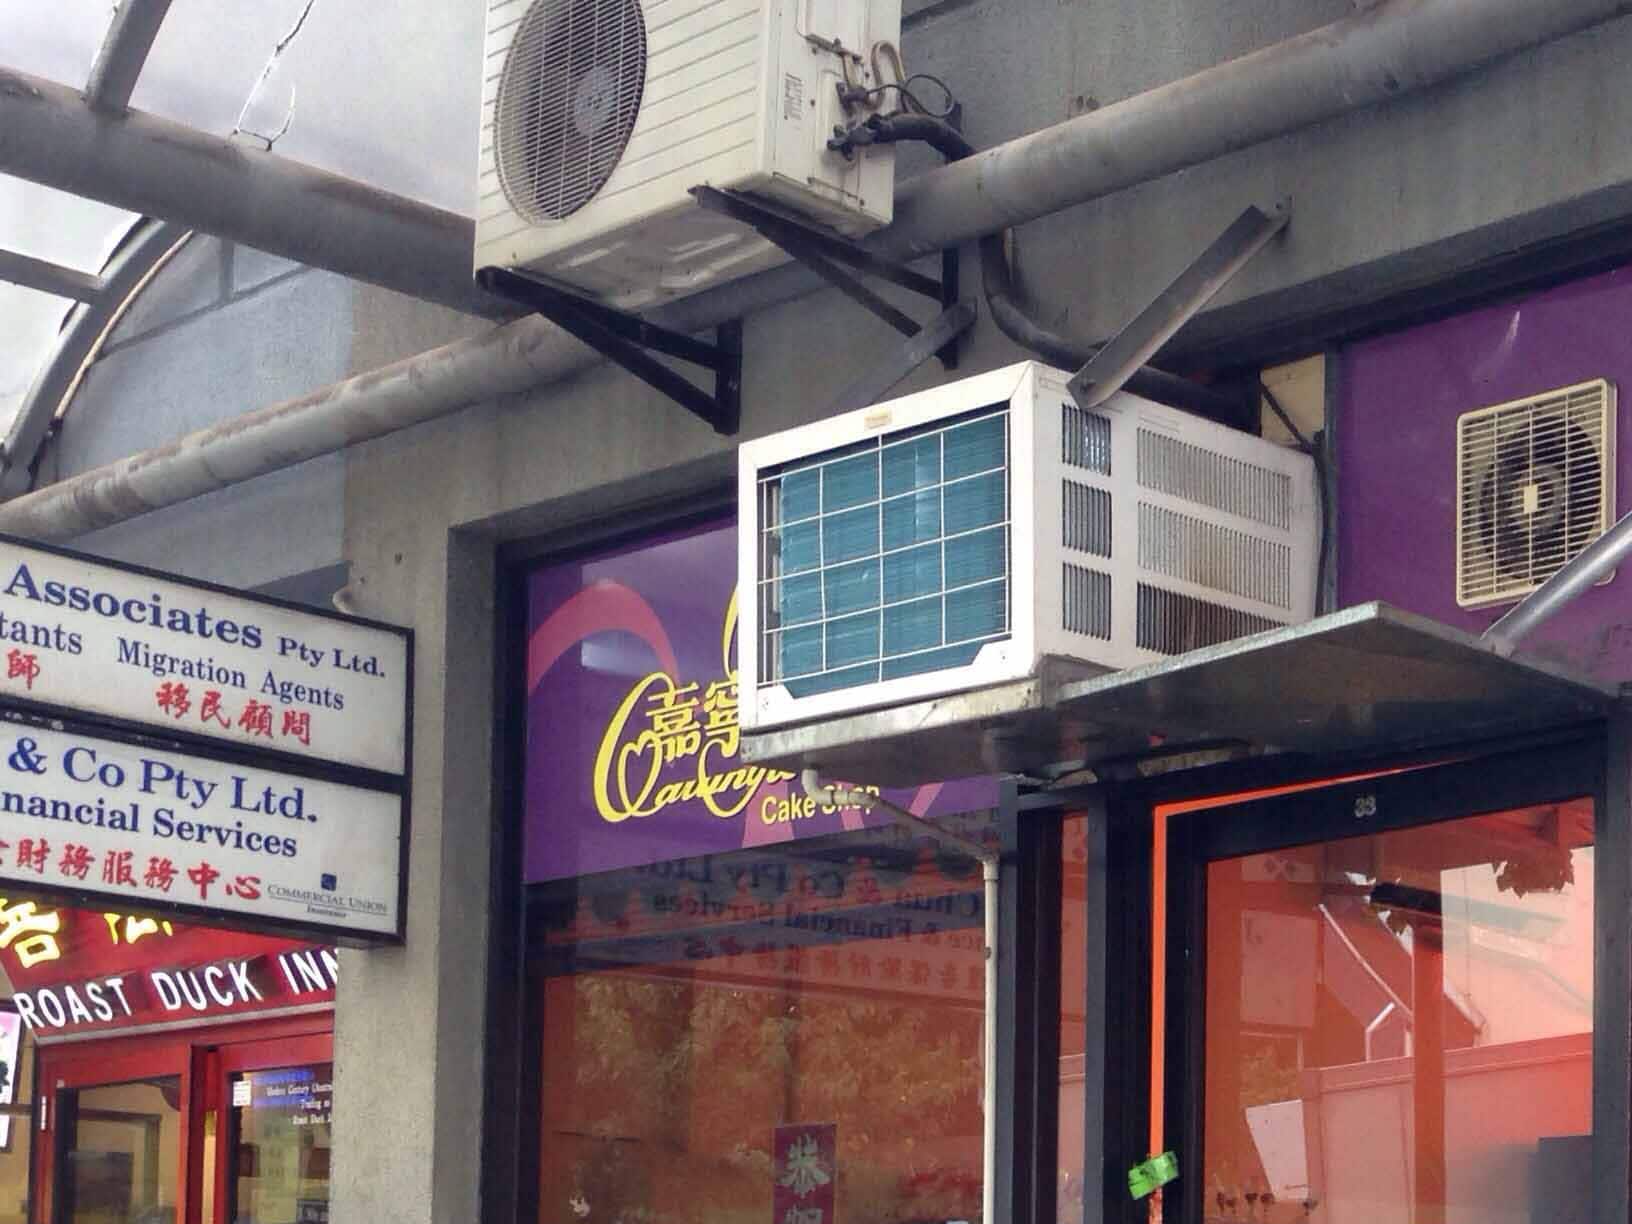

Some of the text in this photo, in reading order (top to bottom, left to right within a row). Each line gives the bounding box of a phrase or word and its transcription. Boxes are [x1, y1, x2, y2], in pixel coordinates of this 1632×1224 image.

[3, 564, 386, 678] Associates Pty Ltd.
[117, 637, 247, 689] Migration
[261, 671, 345, 711] Agents
[155, 682, 312, 747] 移民顧問
[8, 737, 319, 823] & Co Pty Ltd.
[761, 792, 816, 825] Cake
[152, 808, 298, 858] Services
[0, 837, 262, 901] 財務服務中心
[13, 977, 133, 1030] ROAST
[151, 960, 263, 1012] DUCK
